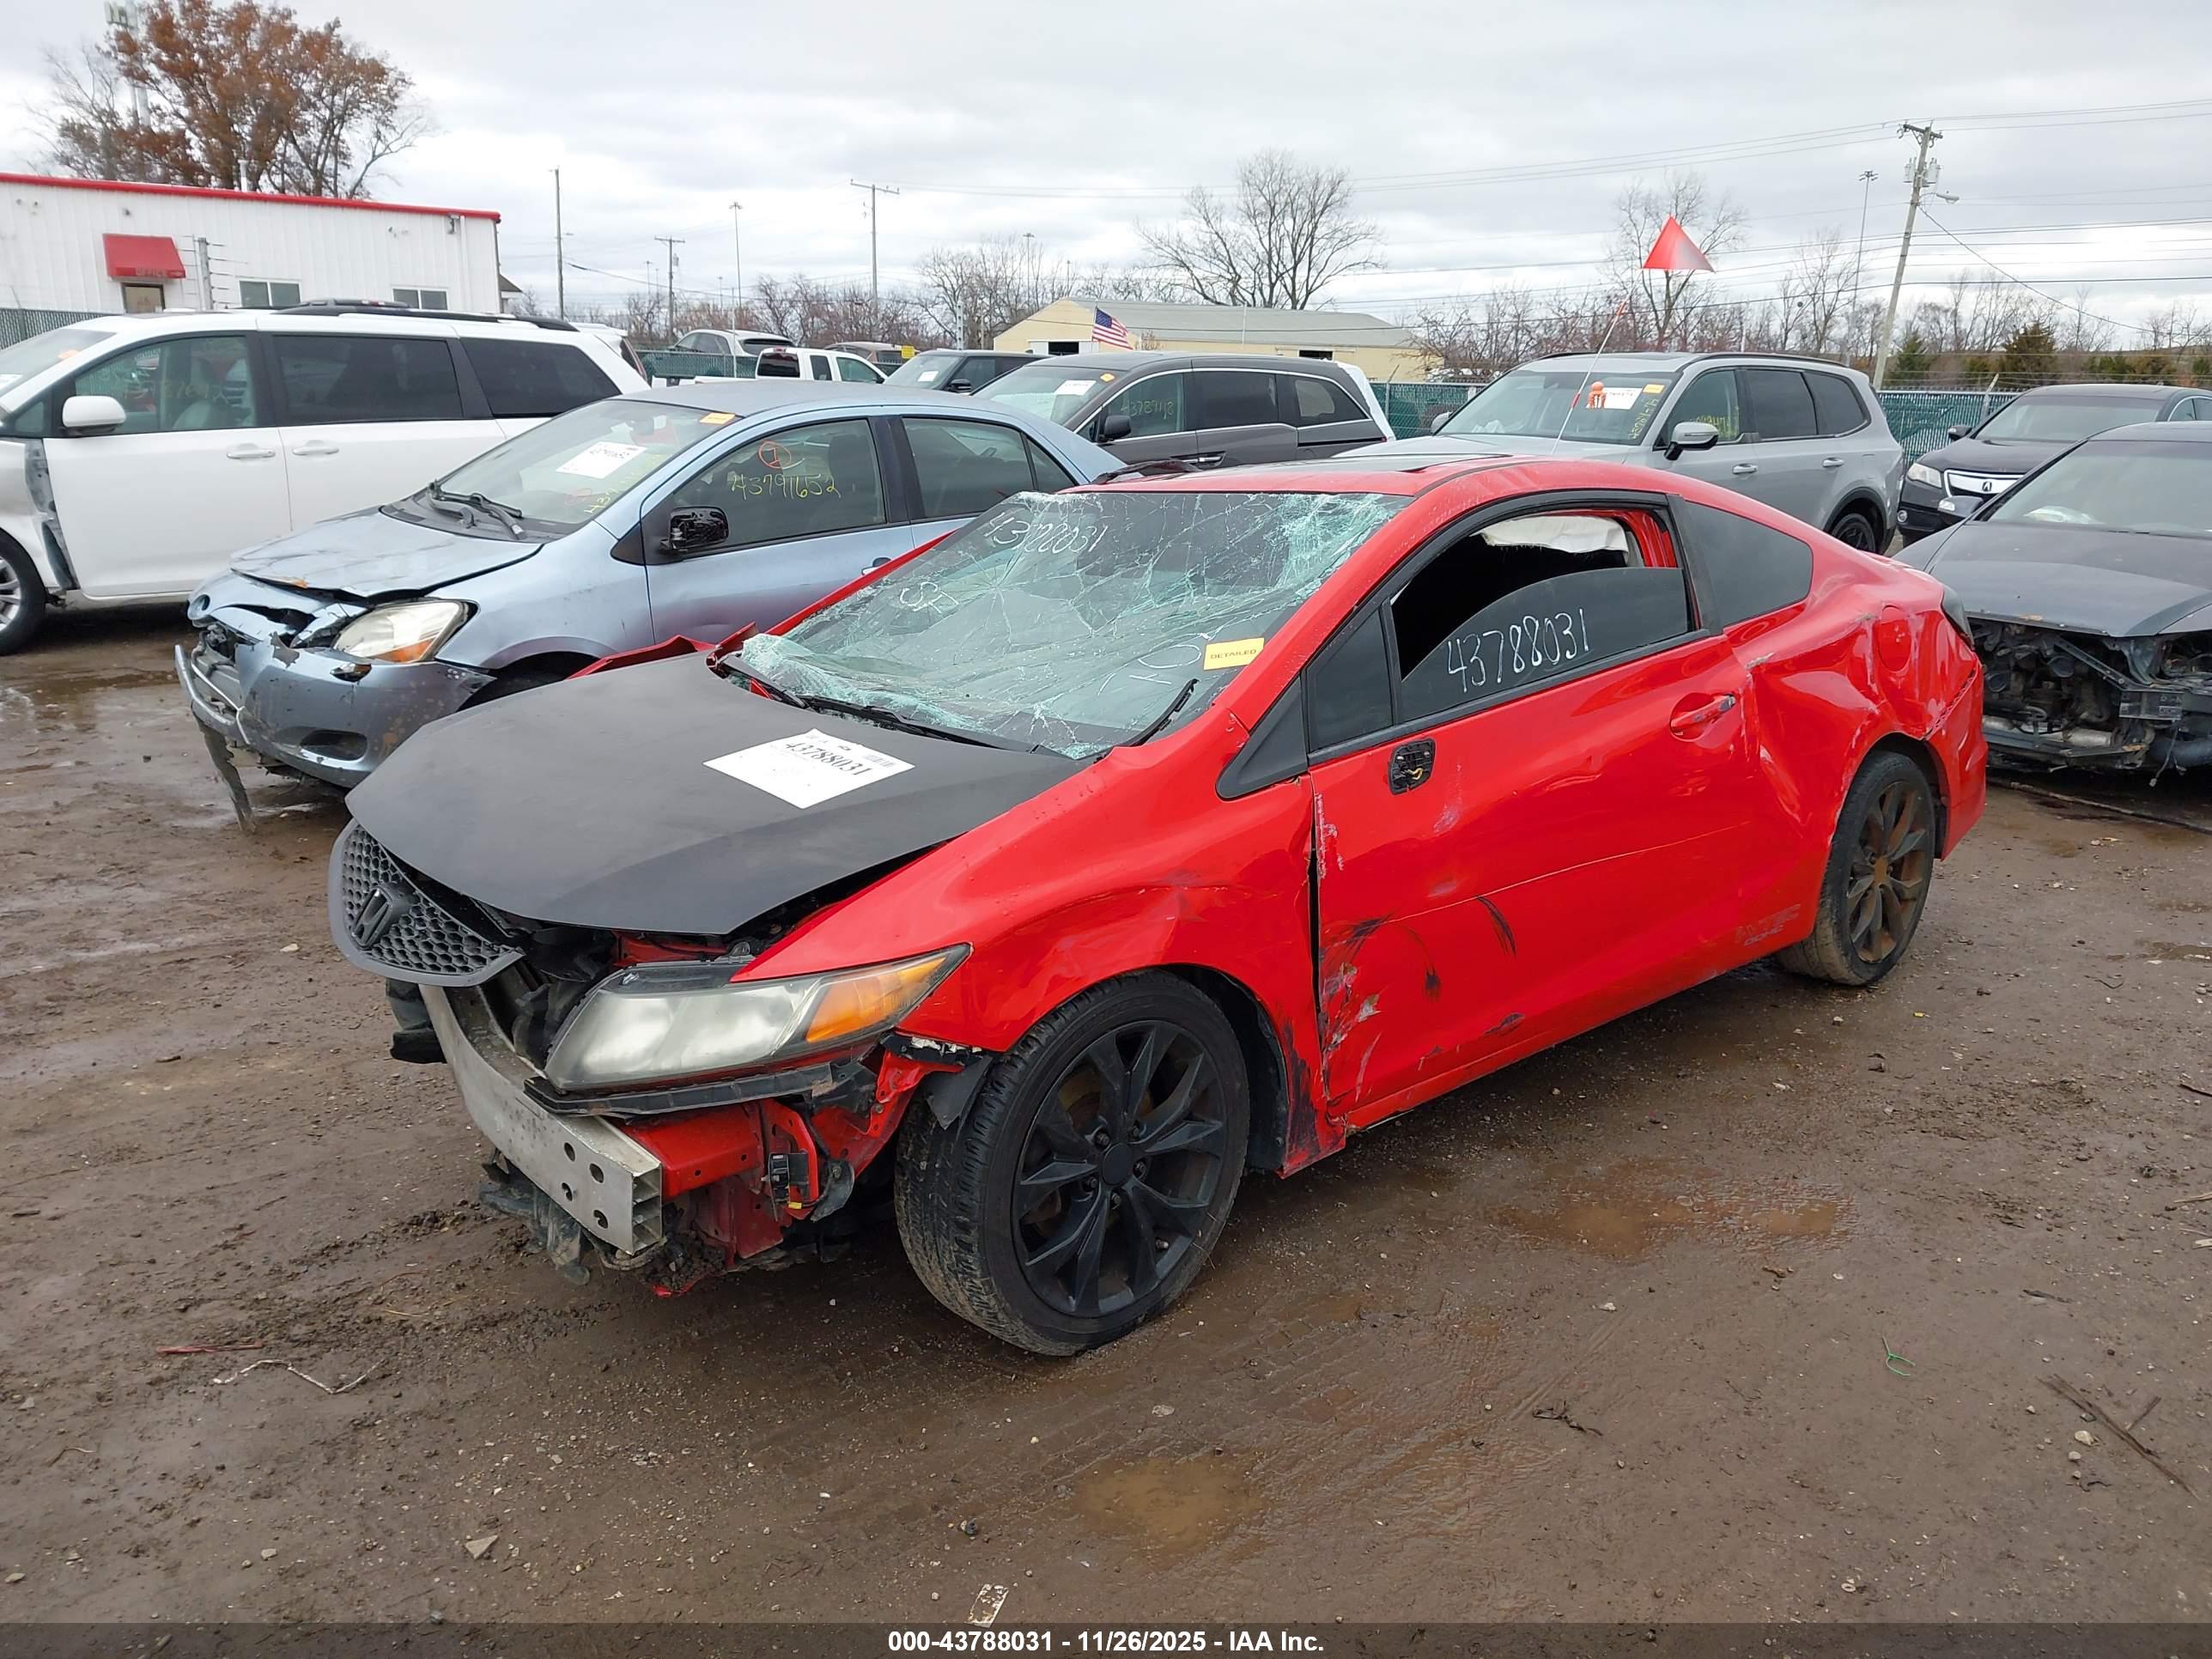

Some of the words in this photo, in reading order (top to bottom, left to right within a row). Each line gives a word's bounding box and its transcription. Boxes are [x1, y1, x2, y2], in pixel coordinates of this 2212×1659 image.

[731, 473, 842, 501] 43791652
[1210, 648, 1257, 659] DETAILED
[1448, 608, 1589, 693] 43788031
[786, 742, 873, 776] 43788031
